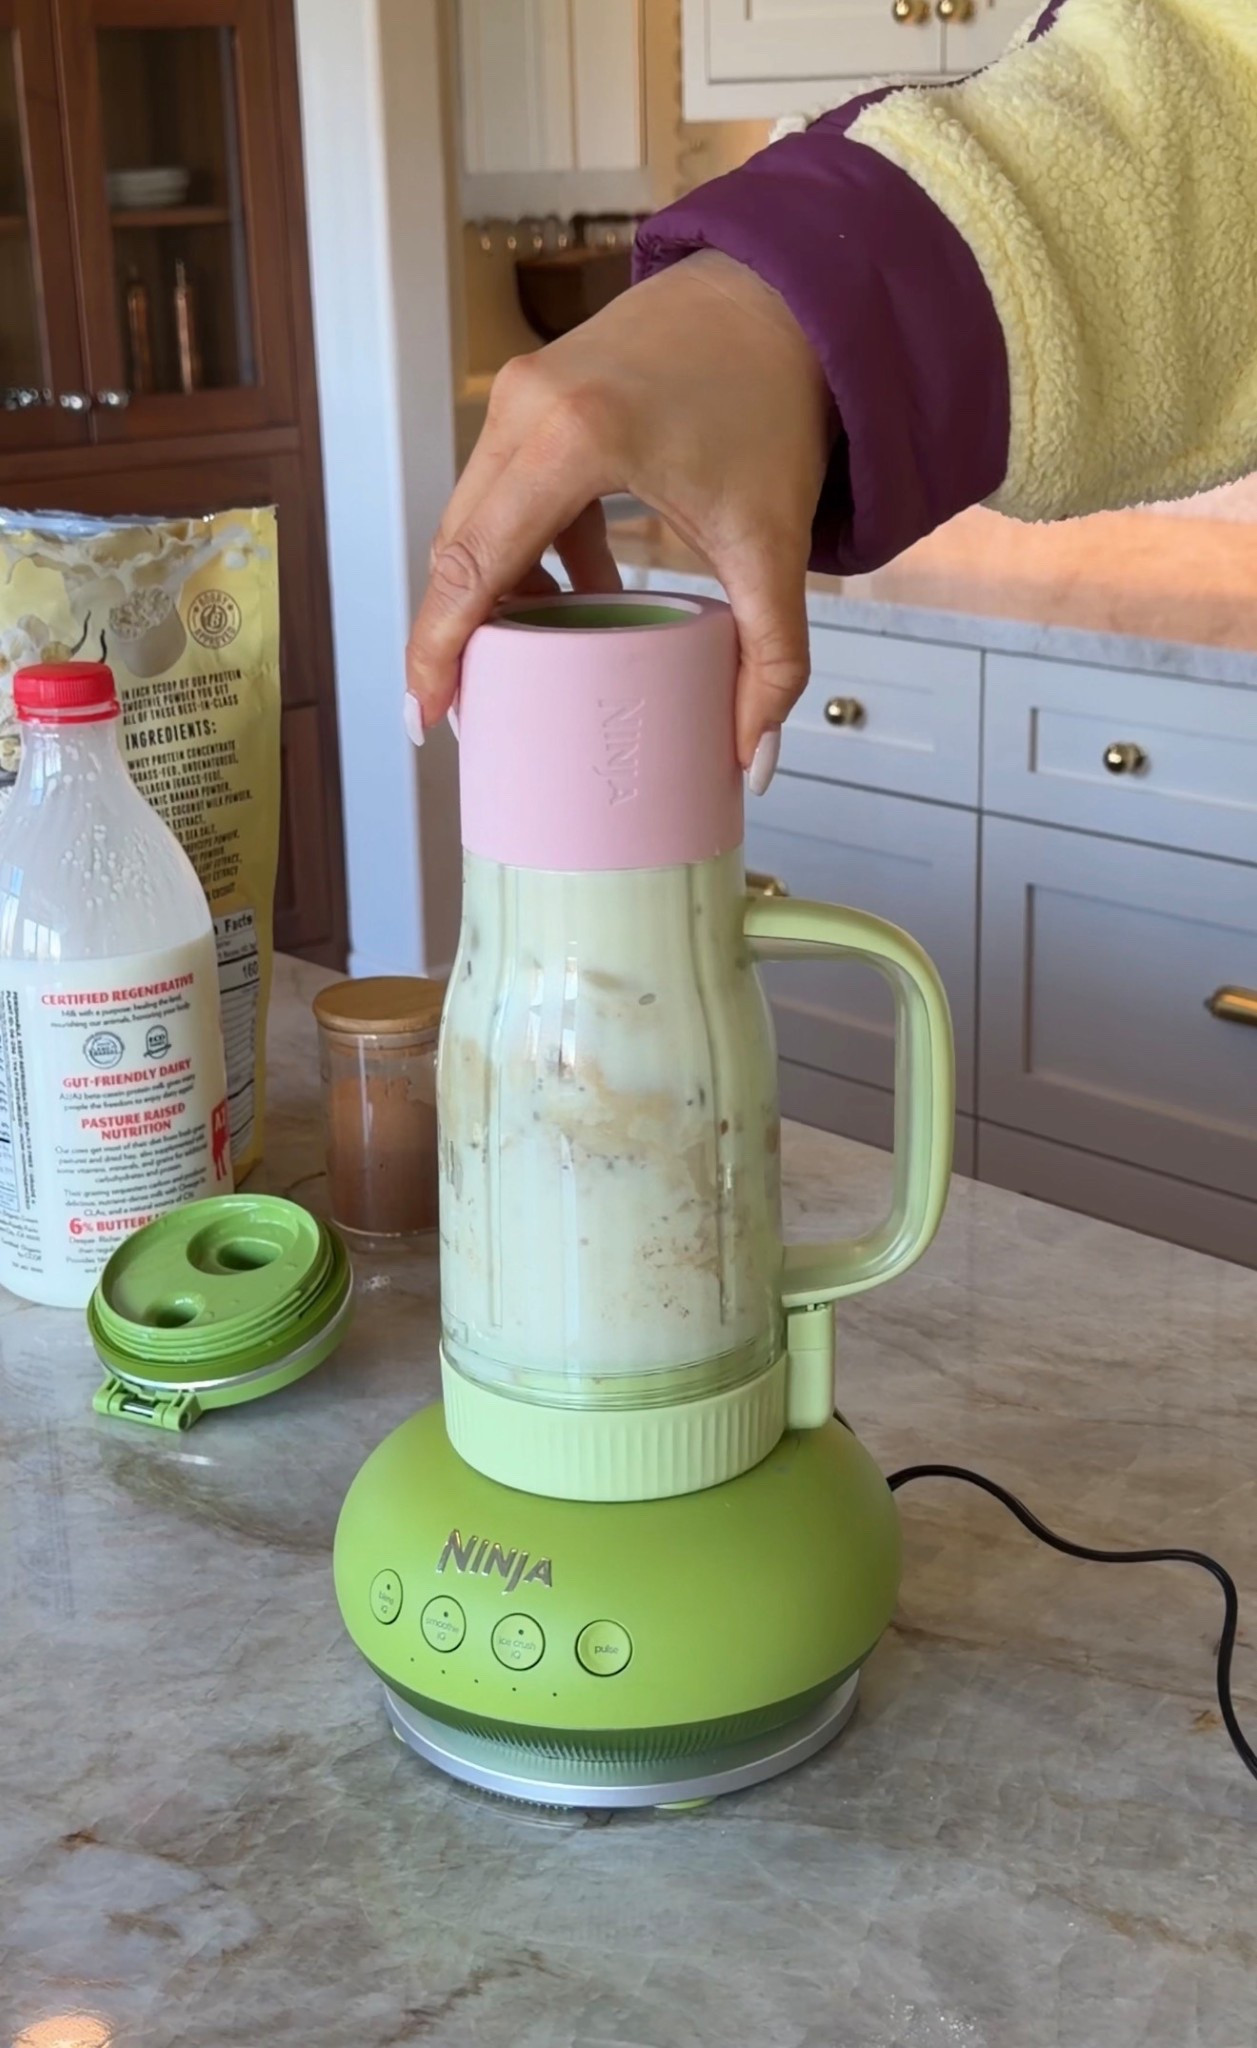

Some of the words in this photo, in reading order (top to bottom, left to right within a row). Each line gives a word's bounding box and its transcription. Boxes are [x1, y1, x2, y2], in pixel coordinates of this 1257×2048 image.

[132, 686, 150, 698] EACH
[153, 680, 176, 695] SCOOP
[180, 678, 189, 690] OF
[192, 675, 207, 688] OUR
[210, 669, 241, 685] PROTEIN
[123, 697, 160, 714] SMOOTHIE
[164, 690, 195, 705] POWDER
[198, 686, 213, 698] YOU
[215, 683, 229, 695] GET
[124, 713, 136, 726] ALL
[138, 712, 148, 723] OF
[151, 706, 176, 721] THESE
[178, 694, 238, 714] BEST-IN-CLASS
[126, 719, 216, 750] INGREDIENTS:
[128, 757, 150, 770] WHEY
[152, 751, 184, 766] PROTEIN
[186, 740, 236, 760] CONCENTRATE
[592, 698, 646, 807] NINJA
[170, 788, 200, 803] BANANA
[172, 800, 204, 816] COCONUT
[224, 914, 252, 932] Facts
[42, 992, 109, 1005] CERTIFIED
[112, 973, 194, 1002] REGENERATIVE
[63, 1067, 157, 1088] GUT-FRIENDLY
[160, 1057, 192, 1077] DAIRY
[81, 1112, 140, 1129] PASTURE
[144, 1102, 186, 1118] RAISED
[101, 1120, 172, 1140] NUTRITION
[436, 1529, 553, 1595] NINJA
[498, 1638, 512, 1646] ice
[513, 1639, 536, 1652] crush
[594, 1644, 620, 1654] pulse
